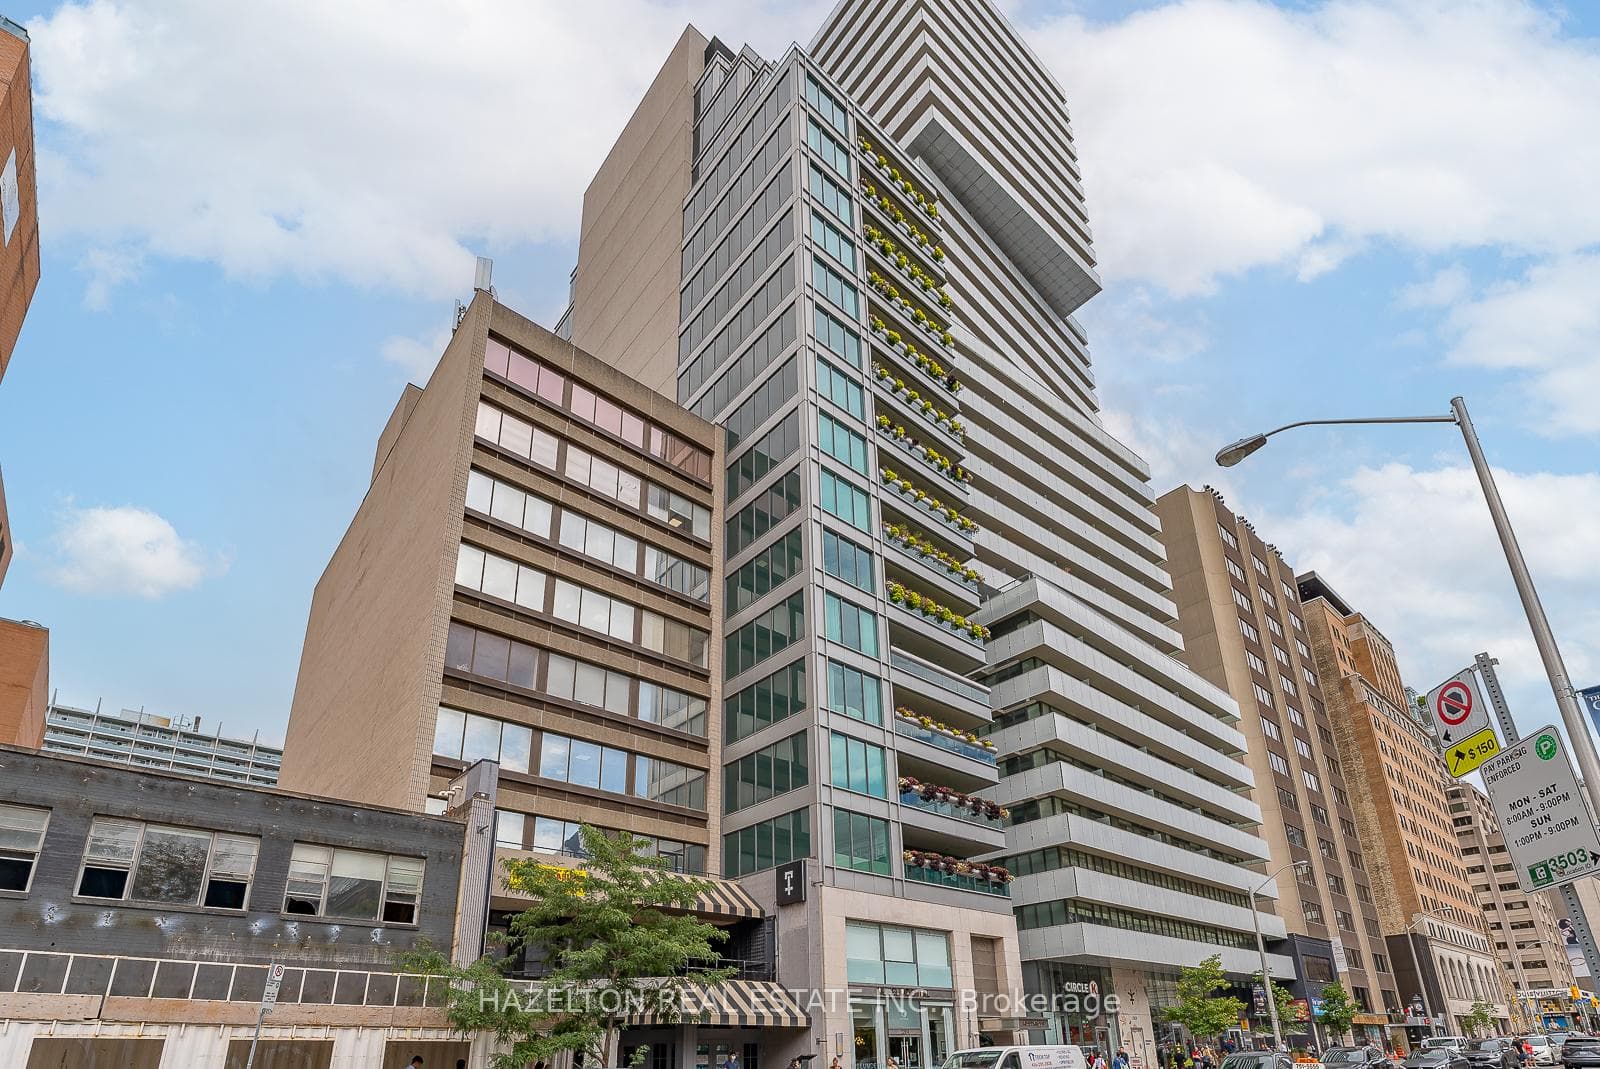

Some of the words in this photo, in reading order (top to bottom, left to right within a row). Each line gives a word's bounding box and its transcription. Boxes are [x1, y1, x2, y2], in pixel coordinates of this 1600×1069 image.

[1468, 748, 1476, 760] $
[1476, 739, 1495, 755] 150
[1483, 763, 1496, 776] PAY
[1497, 746, 1528, 768] PARKNG
[1487, 762, 1521, 785] ENFORCED
[1506, 807, 1535, 826] 8:00AM
[1540, 792, 1571, 811] 9:00PM
[1509, 796, 1531, 811] MON
[1538, 783, 1557, 798] SAT
[1515, 831, 1543, 848] 1:00PM
[1548, 816, 1580, 835] 9:00PM
[1530, 814, 1552, 828] SUN
[1549, 848, 1588, 872] 3503
[1065, 982, 1089, 993] CIRCLE
